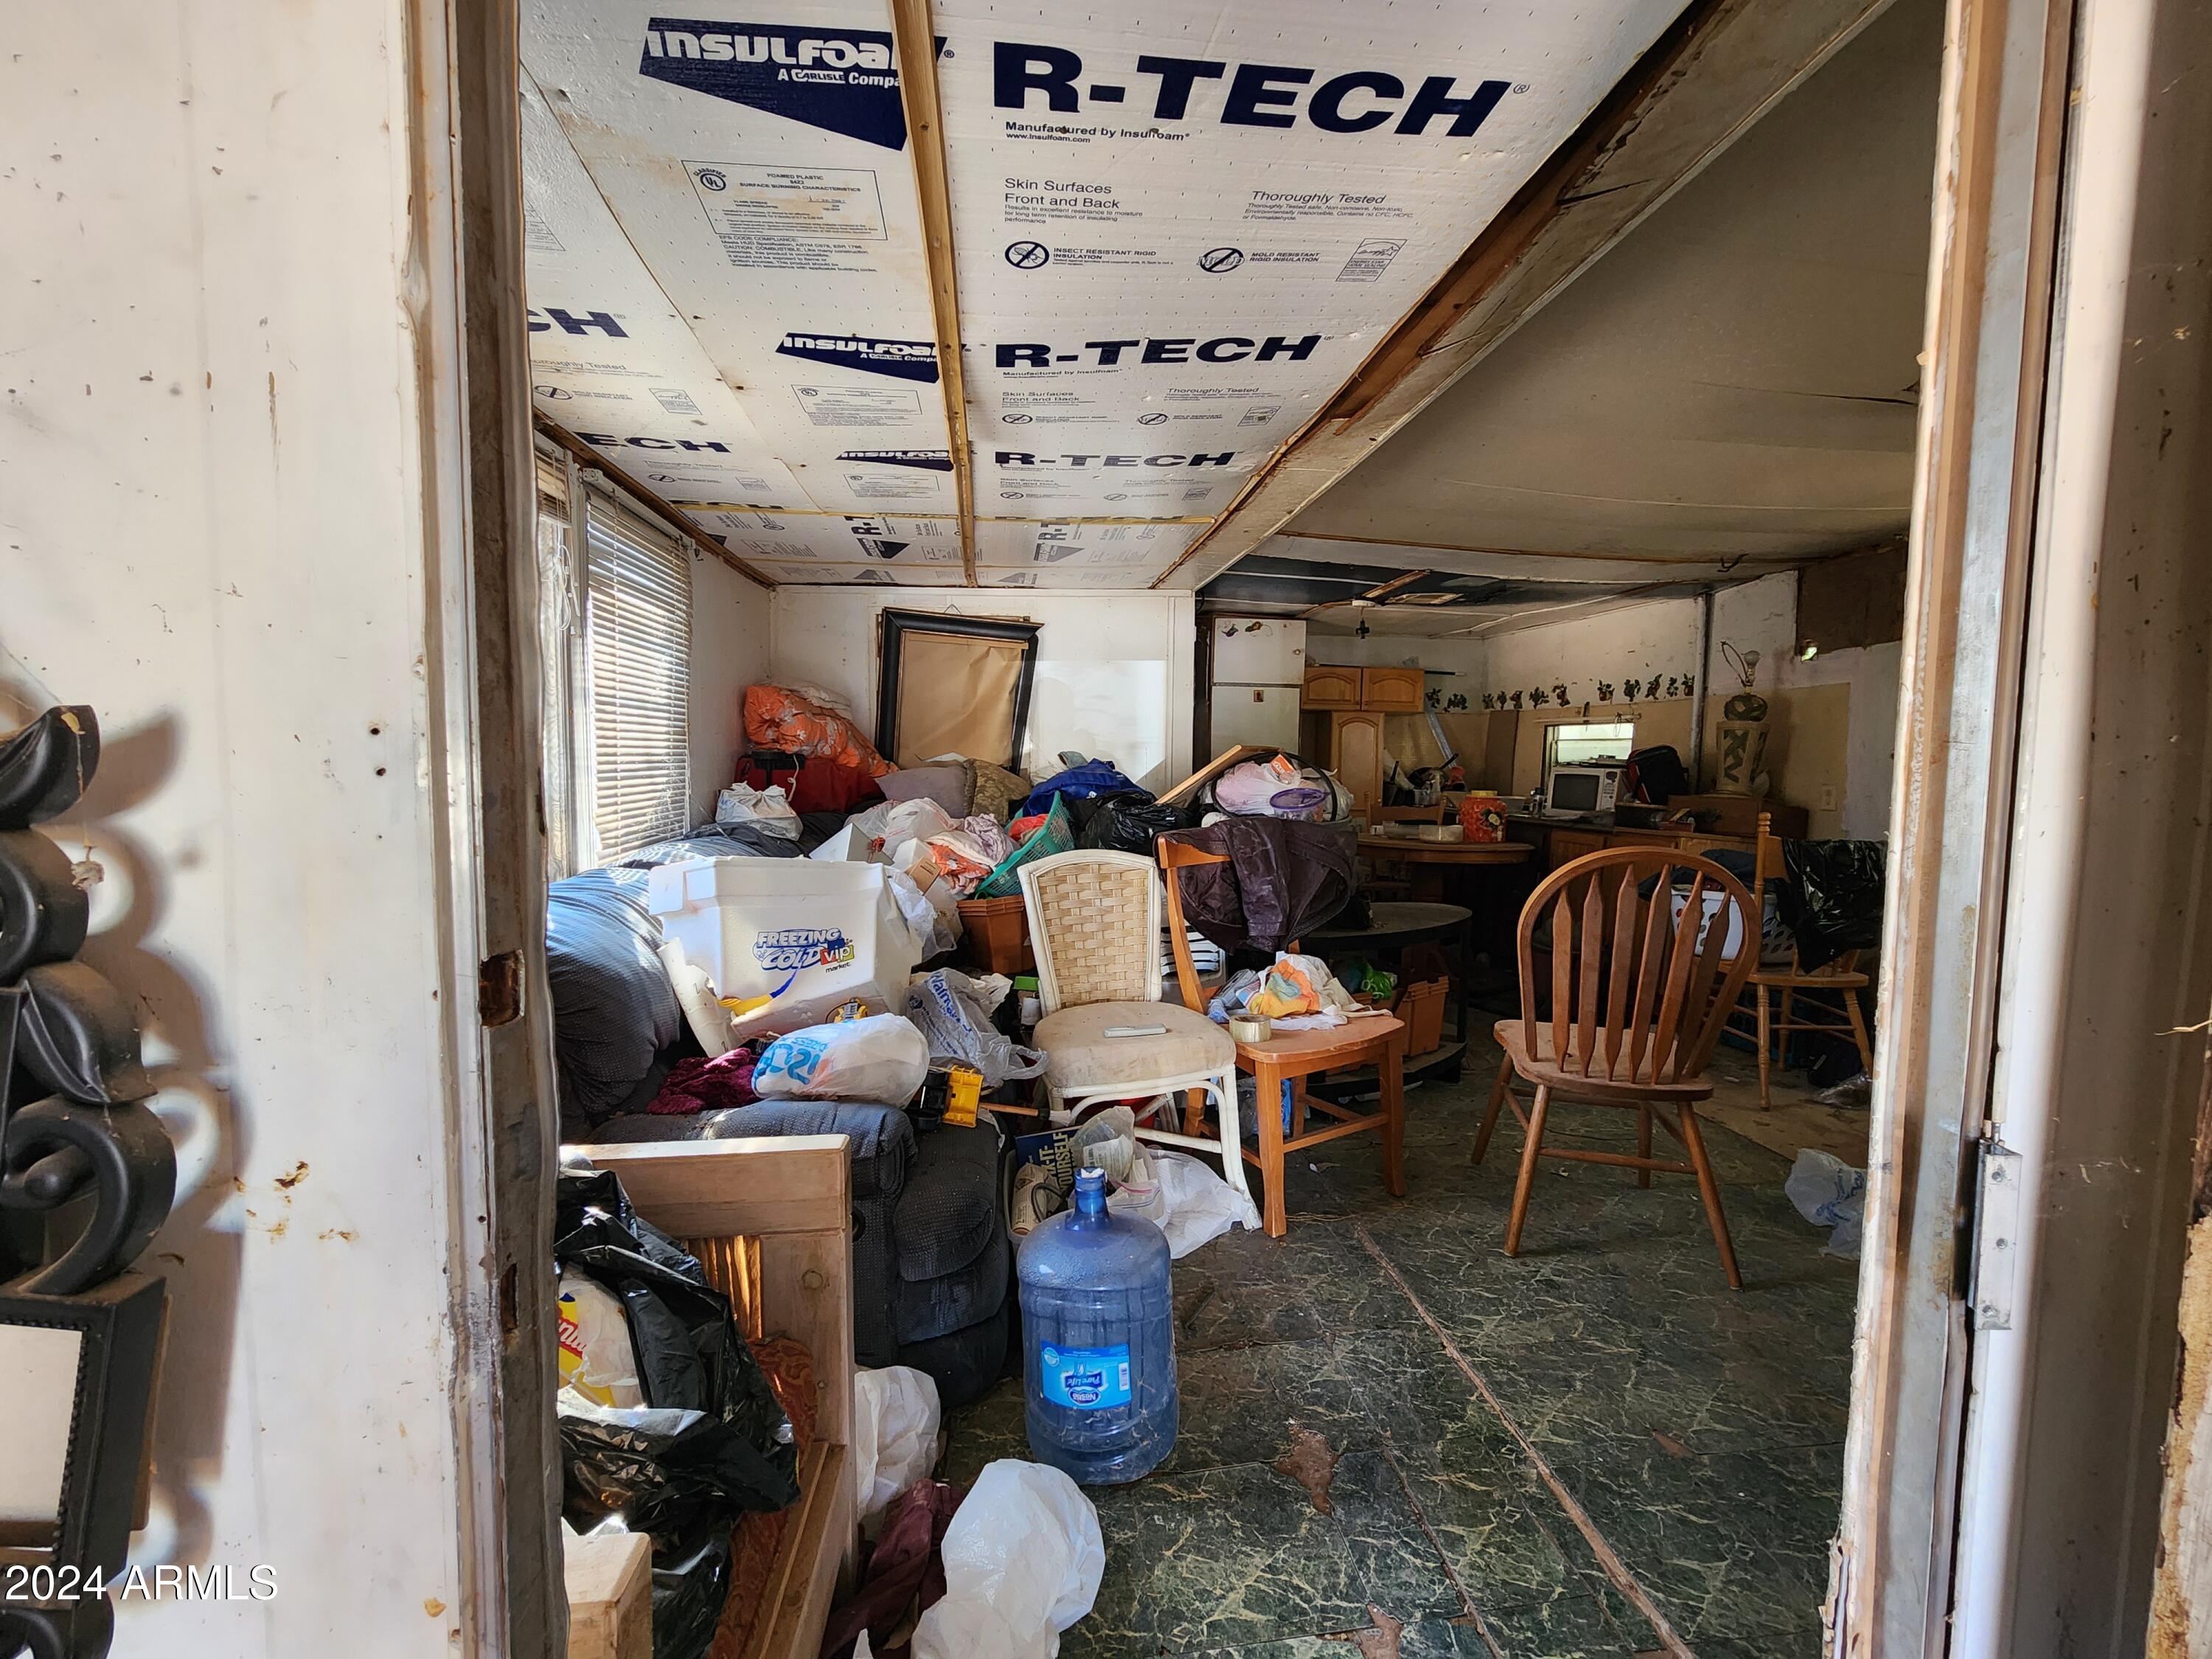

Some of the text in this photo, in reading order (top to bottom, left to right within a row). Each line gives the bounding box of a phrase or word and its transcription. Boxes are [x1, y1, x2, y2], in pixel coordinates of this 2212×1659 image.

[778, 69, 900, 88] A CARLISLE Compa
[994, 41, 1512, 137] R-TECH
[1006, 122, 1096, 136] Manufacured
[1101, 123, 1116, 139] by
[705, 176, 722, 188] UL
[1005, 178, 1112, 194] Skin Surfaces
[1005, 193, 1120, 209] Front and Back
[1253, 191, 1387, 204] Thoroughly Tested
[995, 334, 1324, 368] R-TECH
[531, 359, 627, 370] oroughly Tested
[572, 431, 731, 453] ECH
[995, 451, 1235, 467] R-TECH
[757, 928, 842, 948] FREEZING
[762, 947, 824, 970] COLD
[826, 962, 850, 973] market
[1082, 1375, 1101, 1385] Pure
